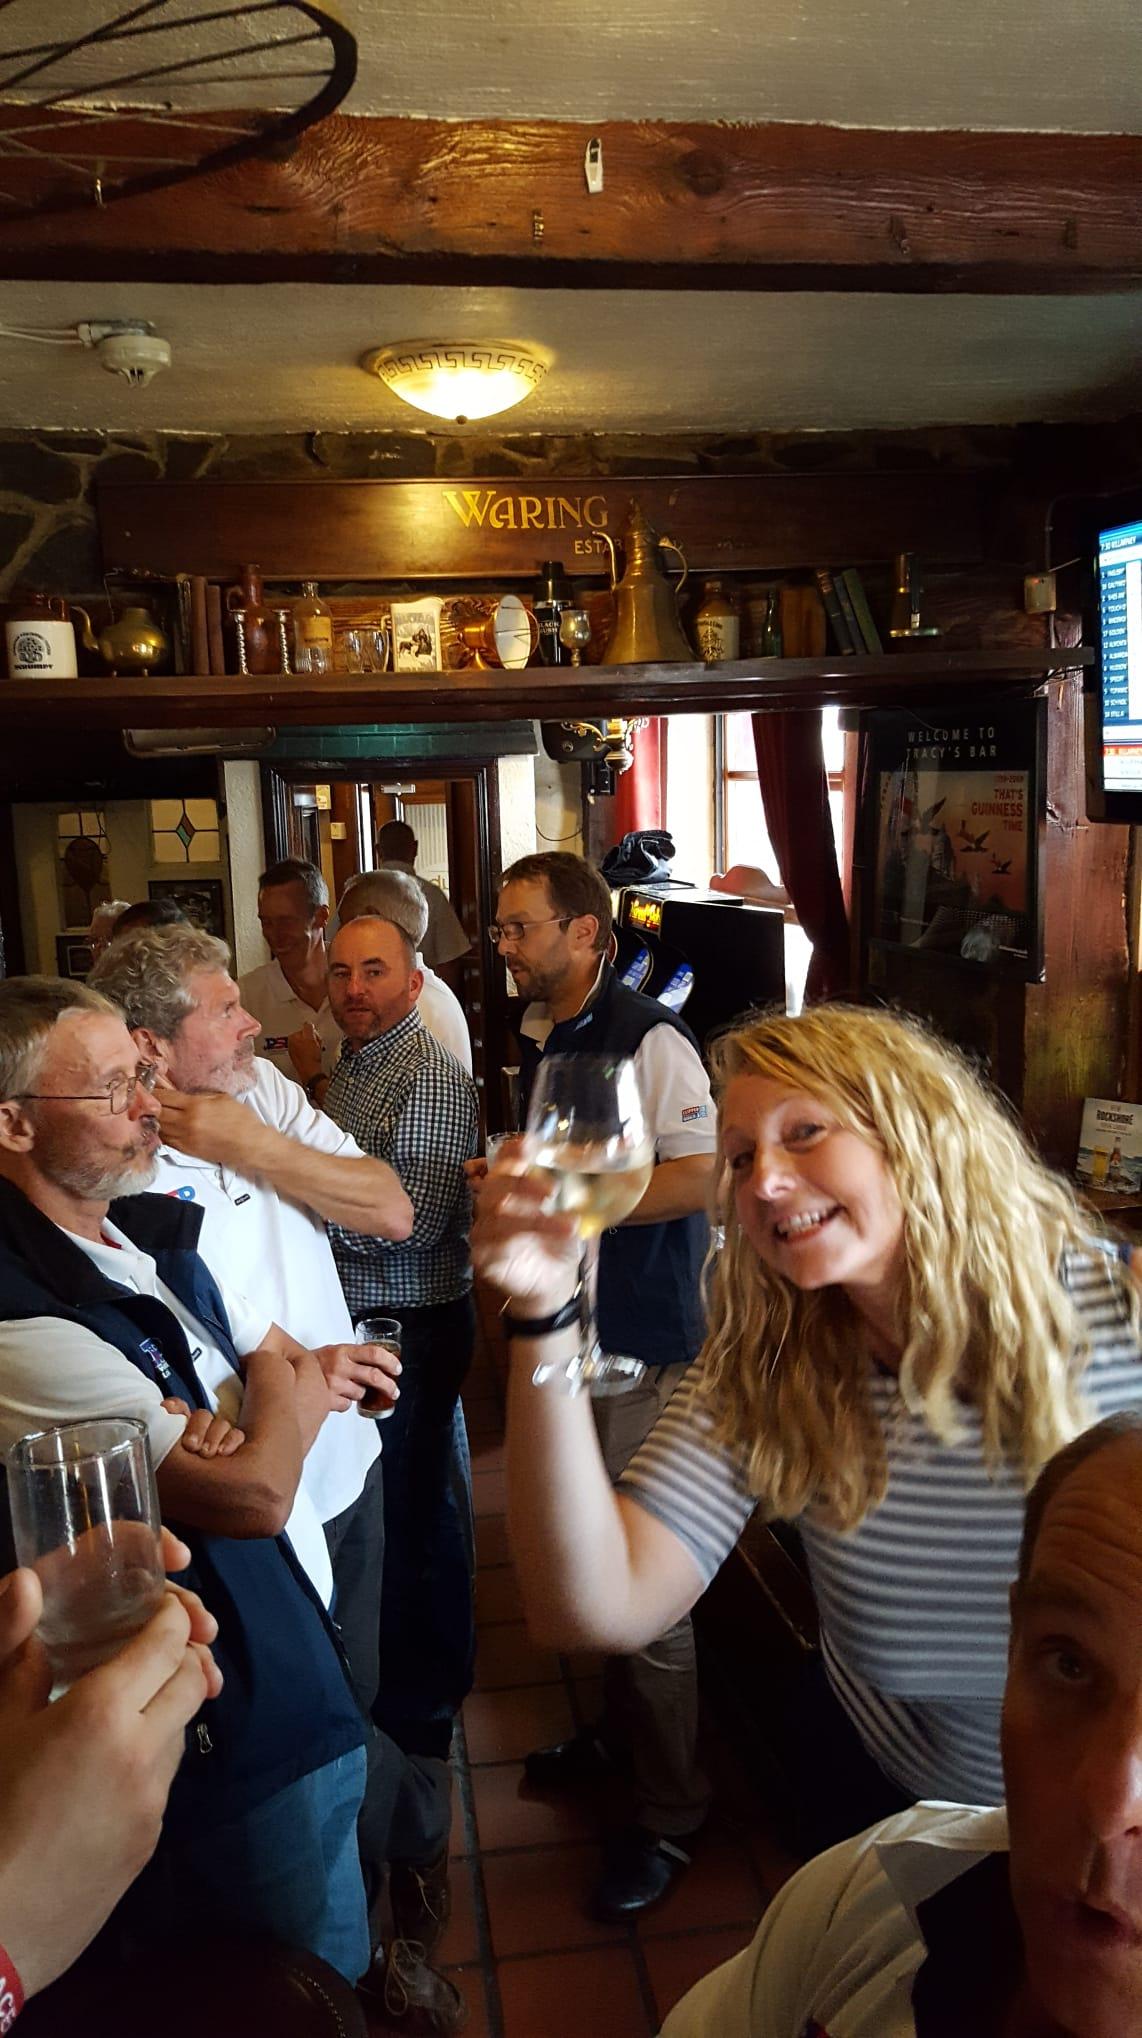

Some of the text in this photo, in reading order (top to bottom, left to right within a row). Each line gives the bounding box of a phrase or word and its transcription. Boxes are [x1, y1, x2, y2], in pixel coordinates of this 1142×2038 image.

[442, 490, 609, 529] WARING
[907, 726, 995, 743] WELCOME TO
[906, 744, 997, 760] TRACY'S BAR
[994, 788, 1024, 800] THAT'S
[971, 802, 1024, 817] GUINNESS
[1003, 820, 1023, 832] TIME
[1096, 1110, 1134, 1125] ROCKSHORE
